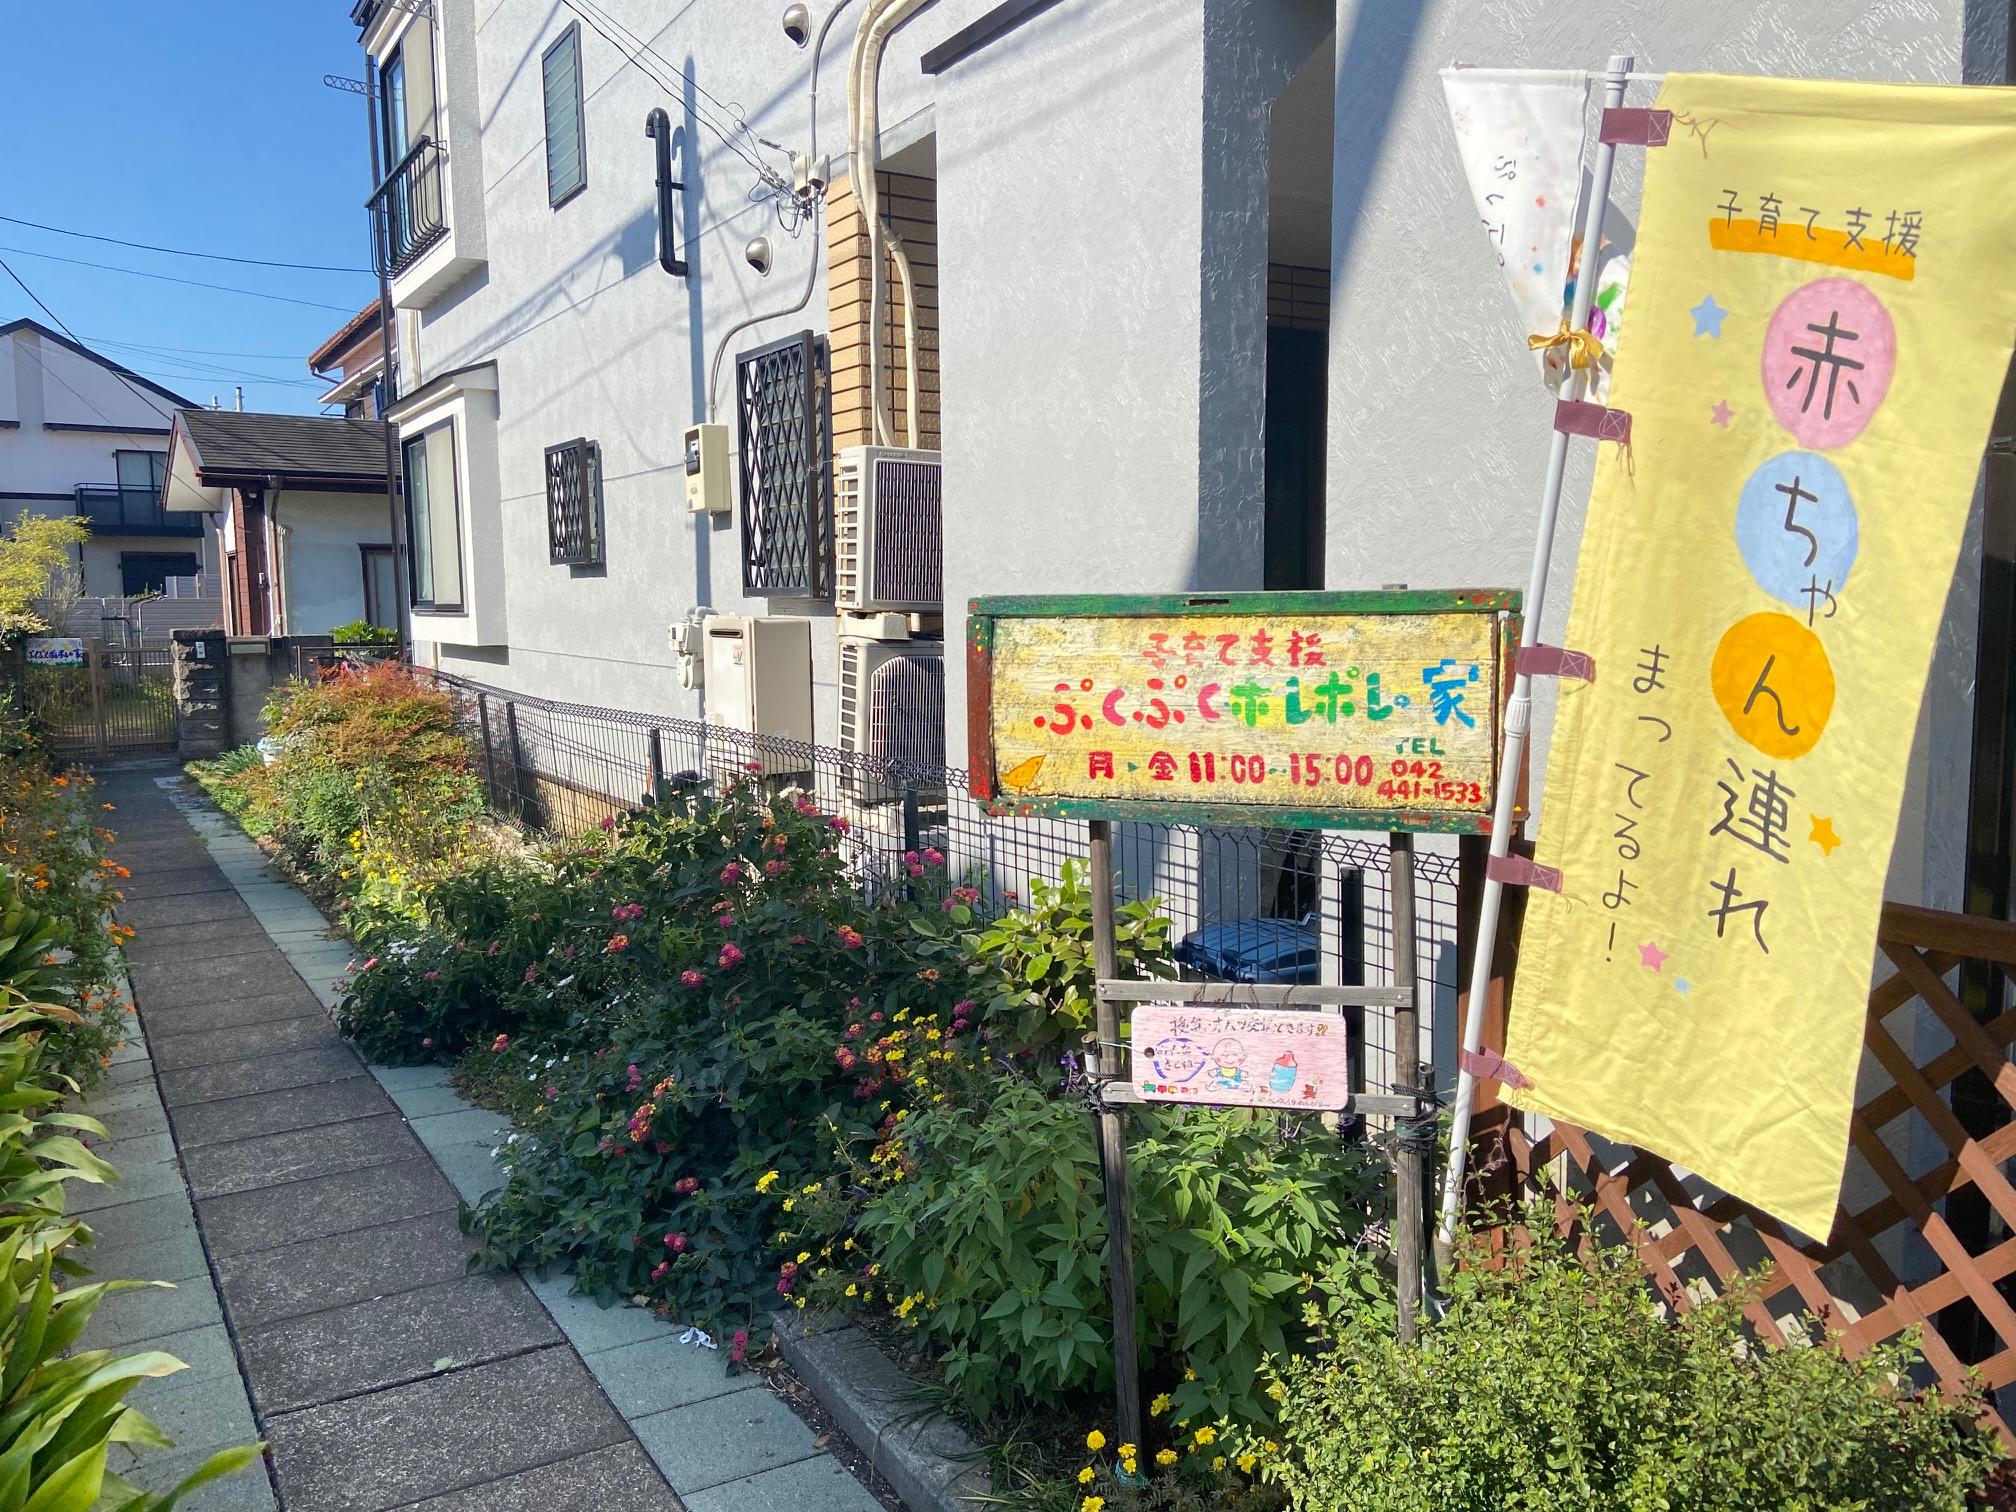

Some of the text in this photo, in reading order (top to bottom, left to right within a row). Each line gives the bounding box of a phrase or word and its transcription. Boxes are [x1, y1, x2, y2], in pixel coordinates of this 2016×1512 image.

[1717, 189, 1923, 258] 子育て支援
[1707, 310, 1865, 954] 赤ちゃん連れ
[1143, 628, 1327, 669] 子育て支援
[1395, 737, 1445, 755] TEL
[1391, 760, 1444, 779] 042
[1377, 780, 1483, 804] 441-1533
